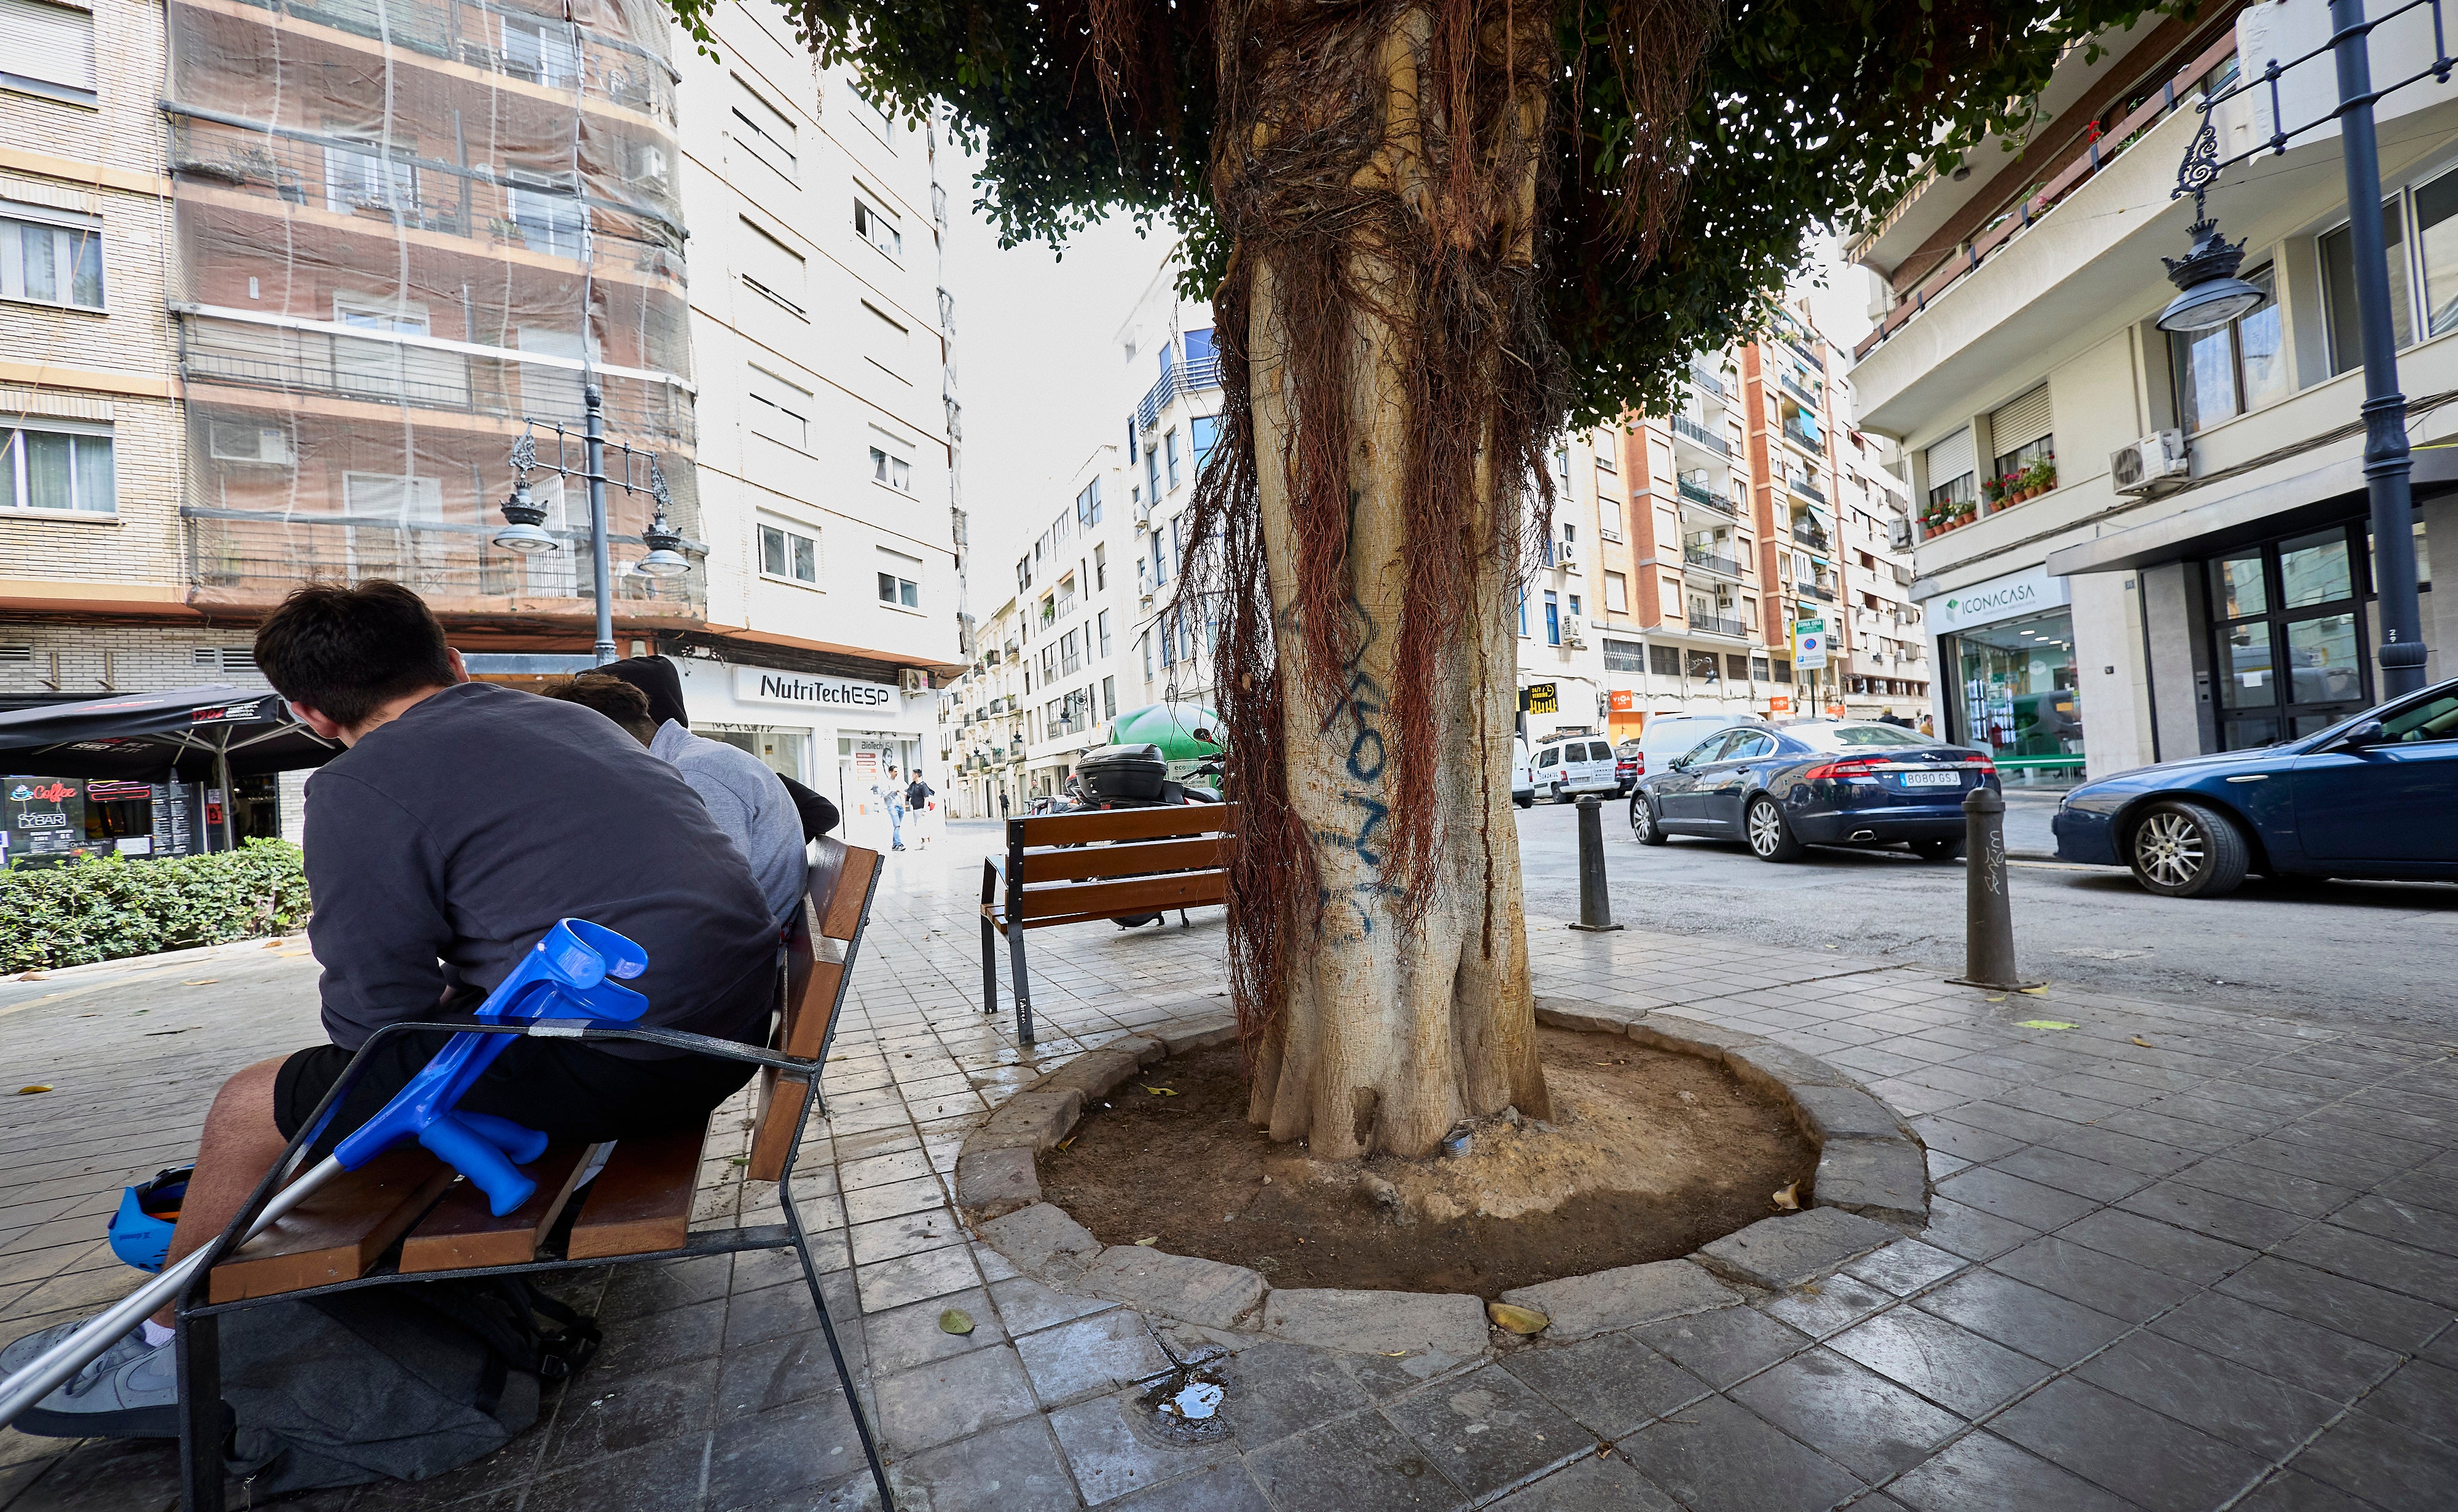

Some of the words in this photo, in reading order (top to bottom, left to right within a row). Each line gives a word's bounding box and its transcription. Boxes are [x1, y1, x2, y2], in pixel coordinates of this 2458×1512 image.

[1962, 585, 2035, 614] ICONACASA
[761, 675, 889, 706] NutriTechESP
[191, 708, 226, 721] 1906
[1908, 774, 1935, 783] 8080
[1939, 774, 1958, 783] GSJ
[33, 783, 77, 803] Coffee
[35, 815, 63, 826] BAR
